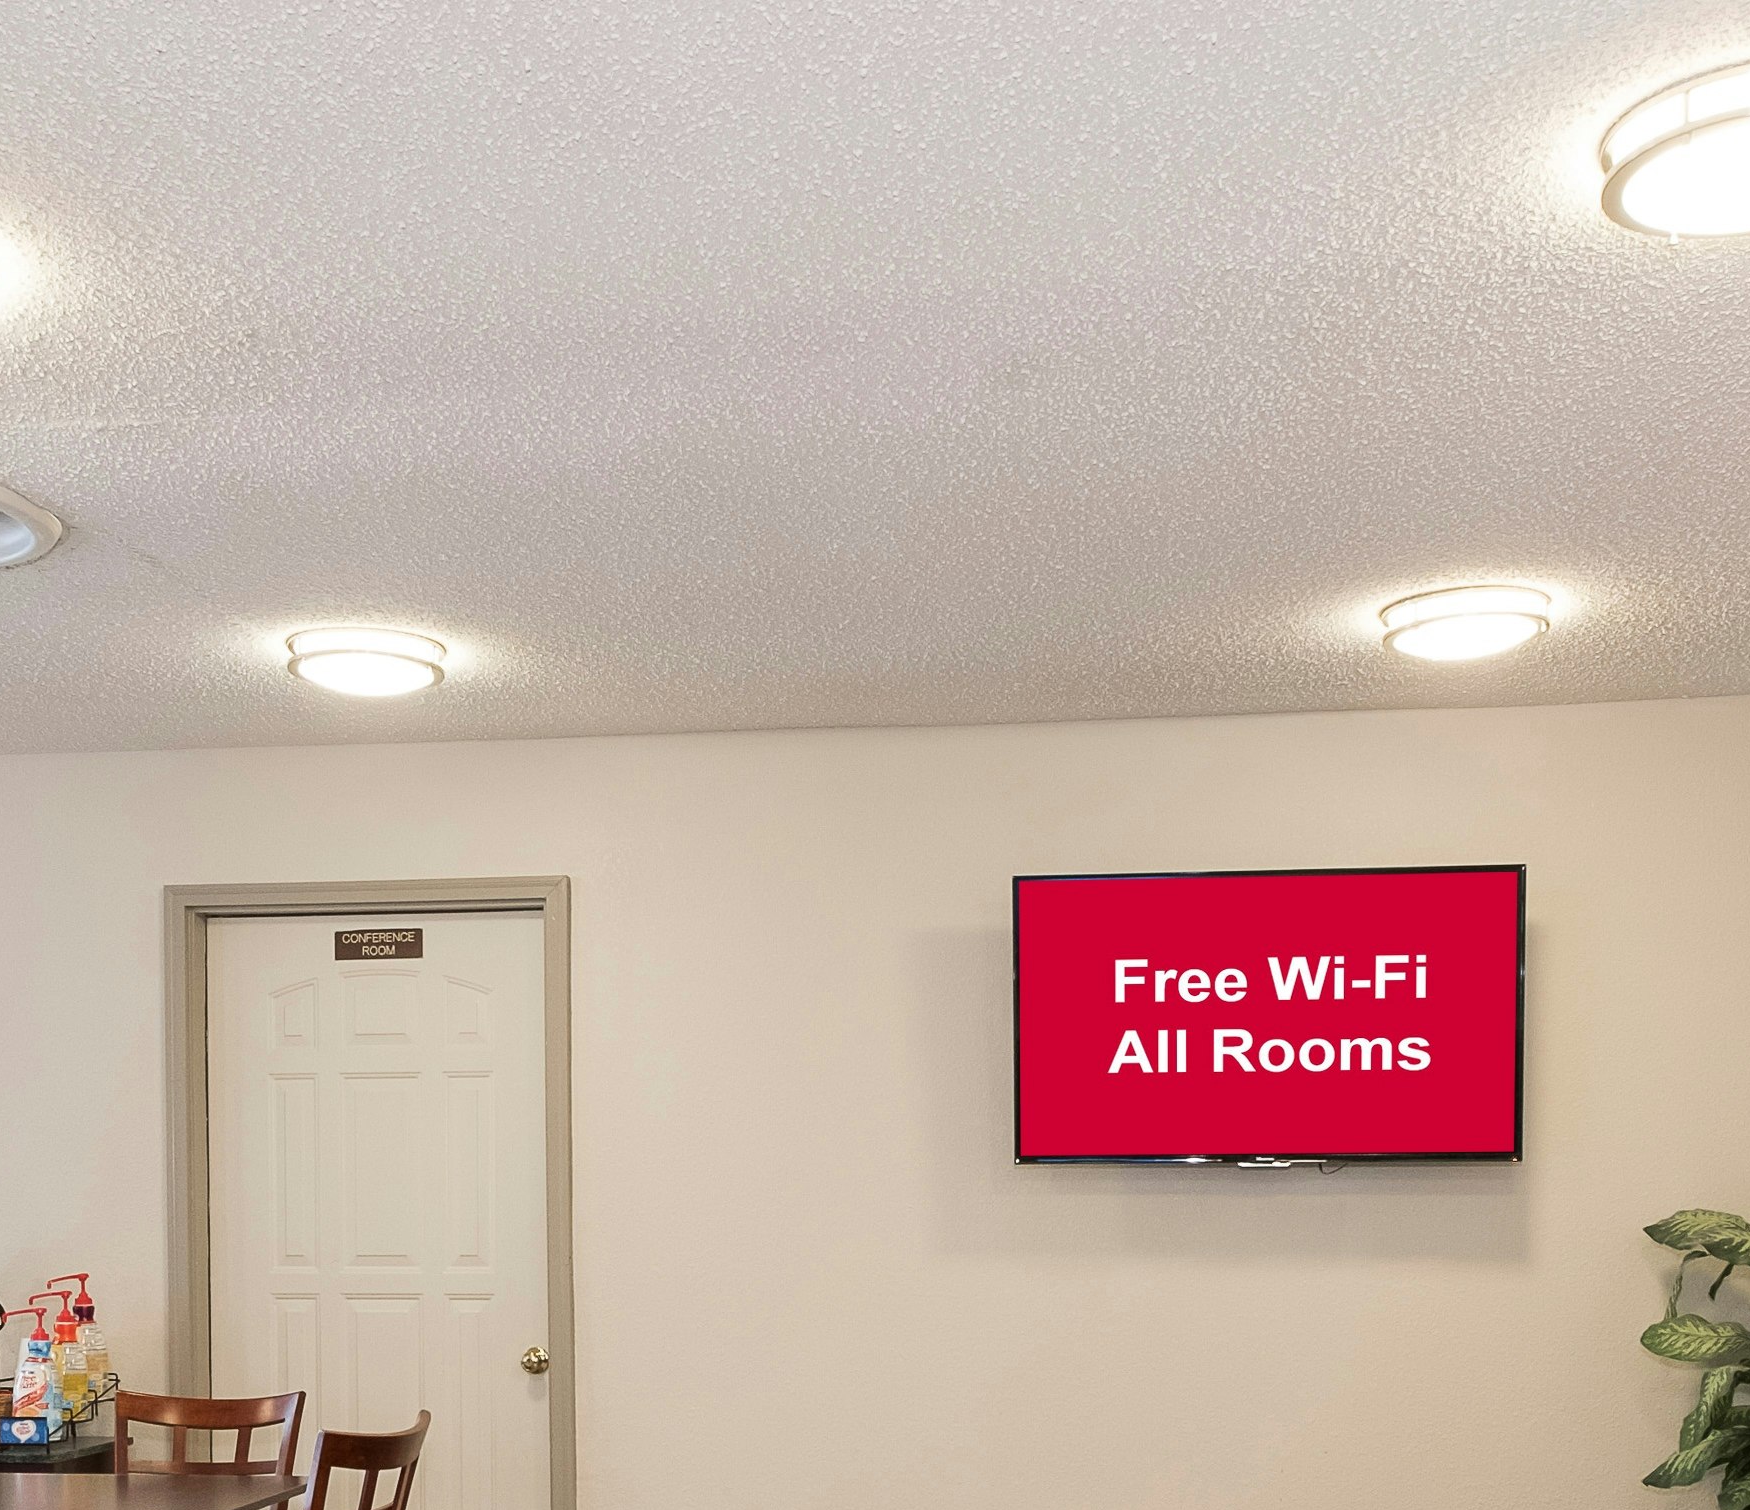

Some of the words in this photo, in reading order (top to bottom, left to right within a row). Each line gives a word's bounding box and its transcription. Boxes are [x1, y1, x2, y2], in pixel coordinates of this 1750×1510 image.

[341, 931, 416, 944] CONFERENCE
[362, 945, 396, 956] ROOM
[1114, 958, 1248, 1003] Free
[1267, 954, 1427, 1001] Wi-Fi
[1107, 1029, 1187, 1074] All
[1213, 1028, 1431, 1073] Rooms
